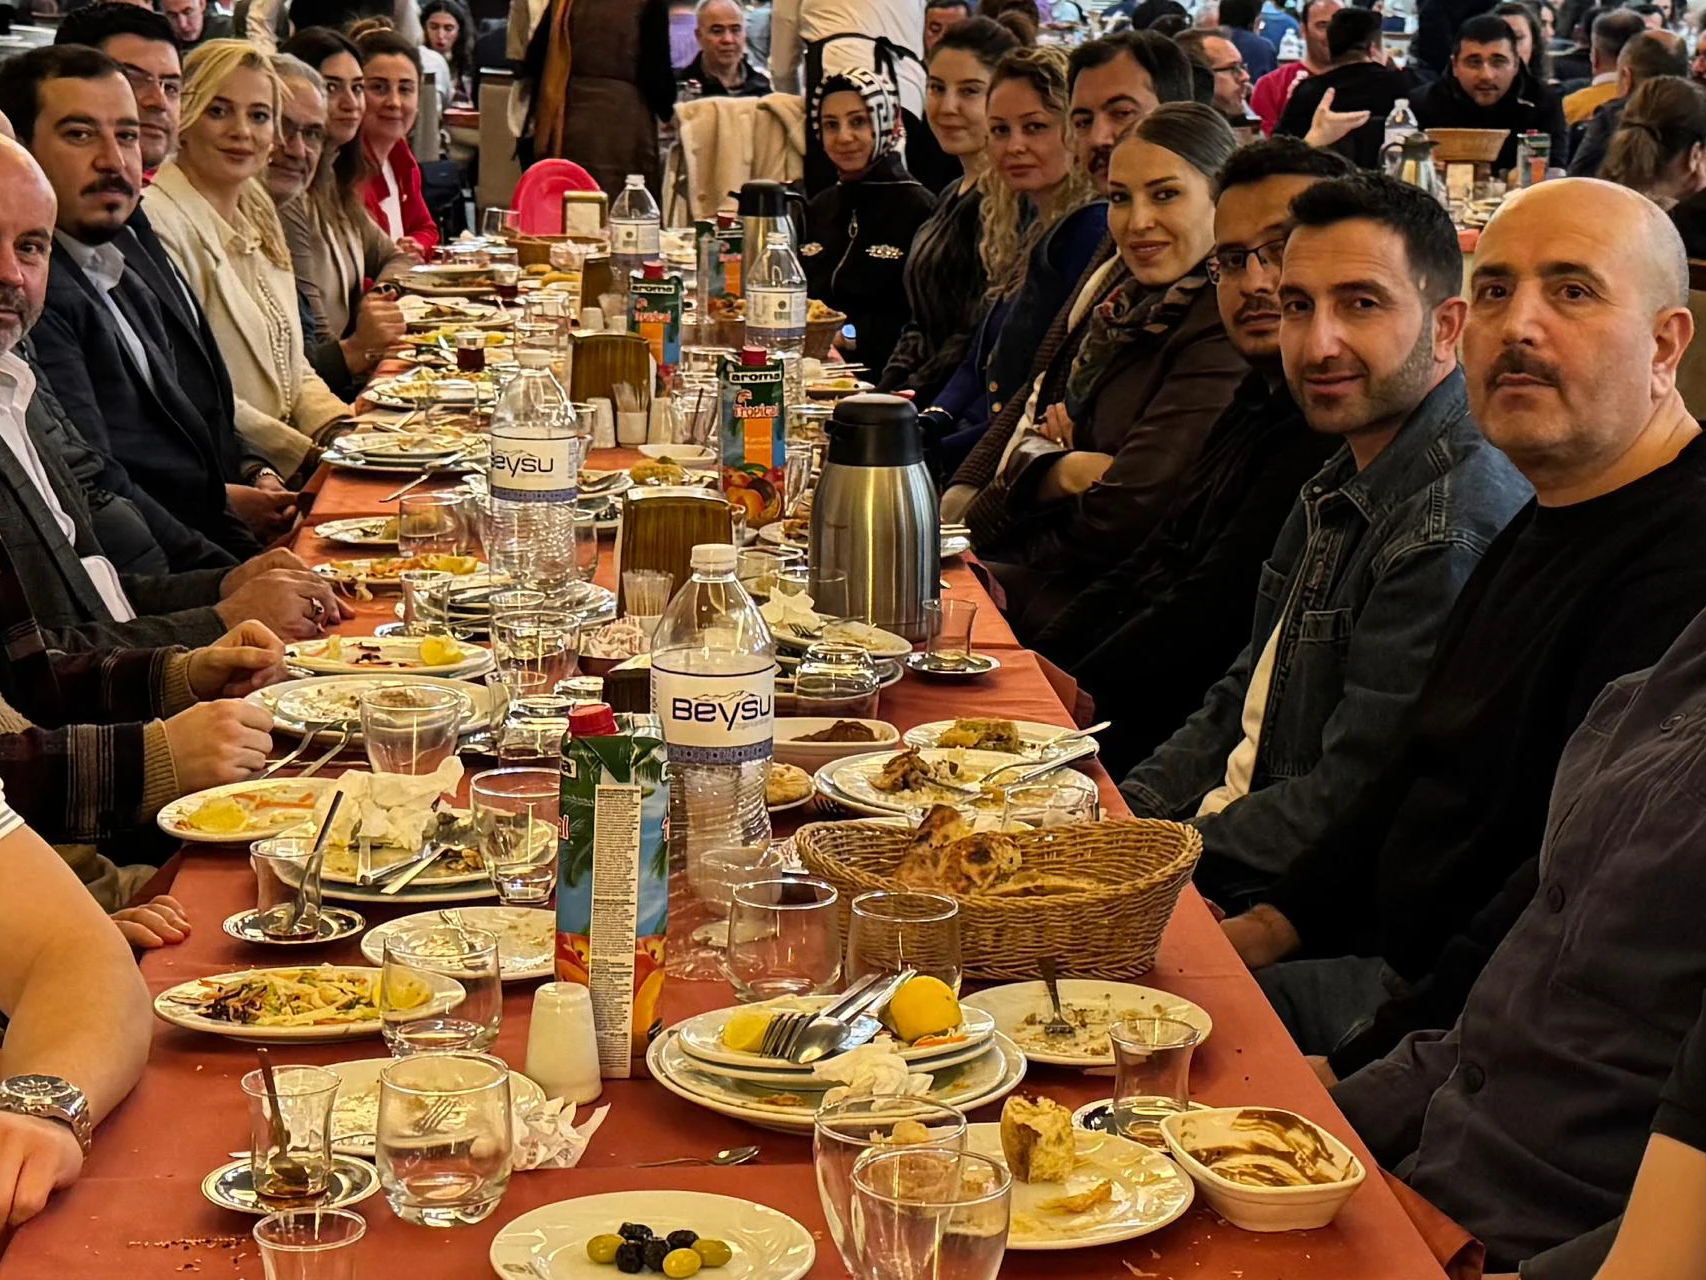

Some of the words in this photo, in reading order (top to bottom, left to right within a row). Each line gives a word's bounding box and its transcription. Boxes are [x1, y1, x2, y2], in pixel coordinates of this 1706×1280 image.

[632, 285, 673, 293] aroma
[731, 372, 781, 381] aroma
[734, 402, 780, 417] Tropical
[491, 453, 554, 478] eysu
[672, 694, 772, 732] Beysu
